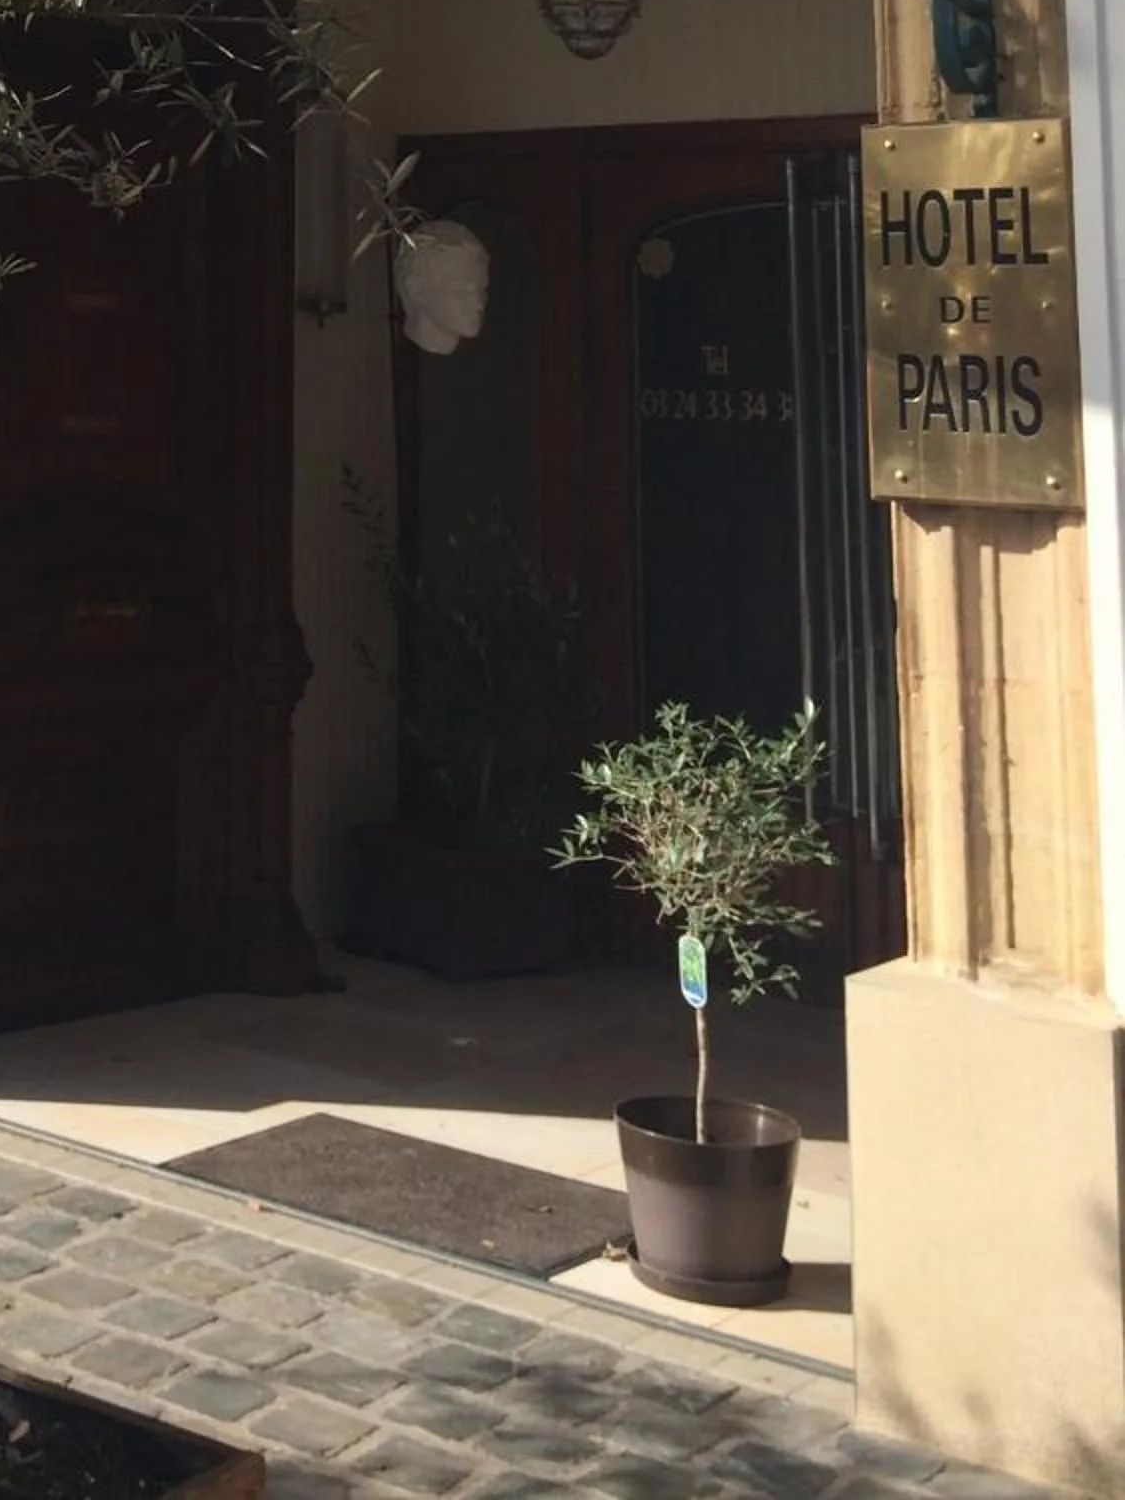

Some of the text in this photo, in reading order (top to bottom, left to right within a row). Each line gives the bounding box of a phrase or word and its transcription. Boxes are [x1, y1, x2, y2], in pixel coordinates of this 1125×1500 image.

[880, 186, 1049, 266] HOTEL
[939, 296, 992, 324] DE
[896, 353, 1044, 437] PARIS
